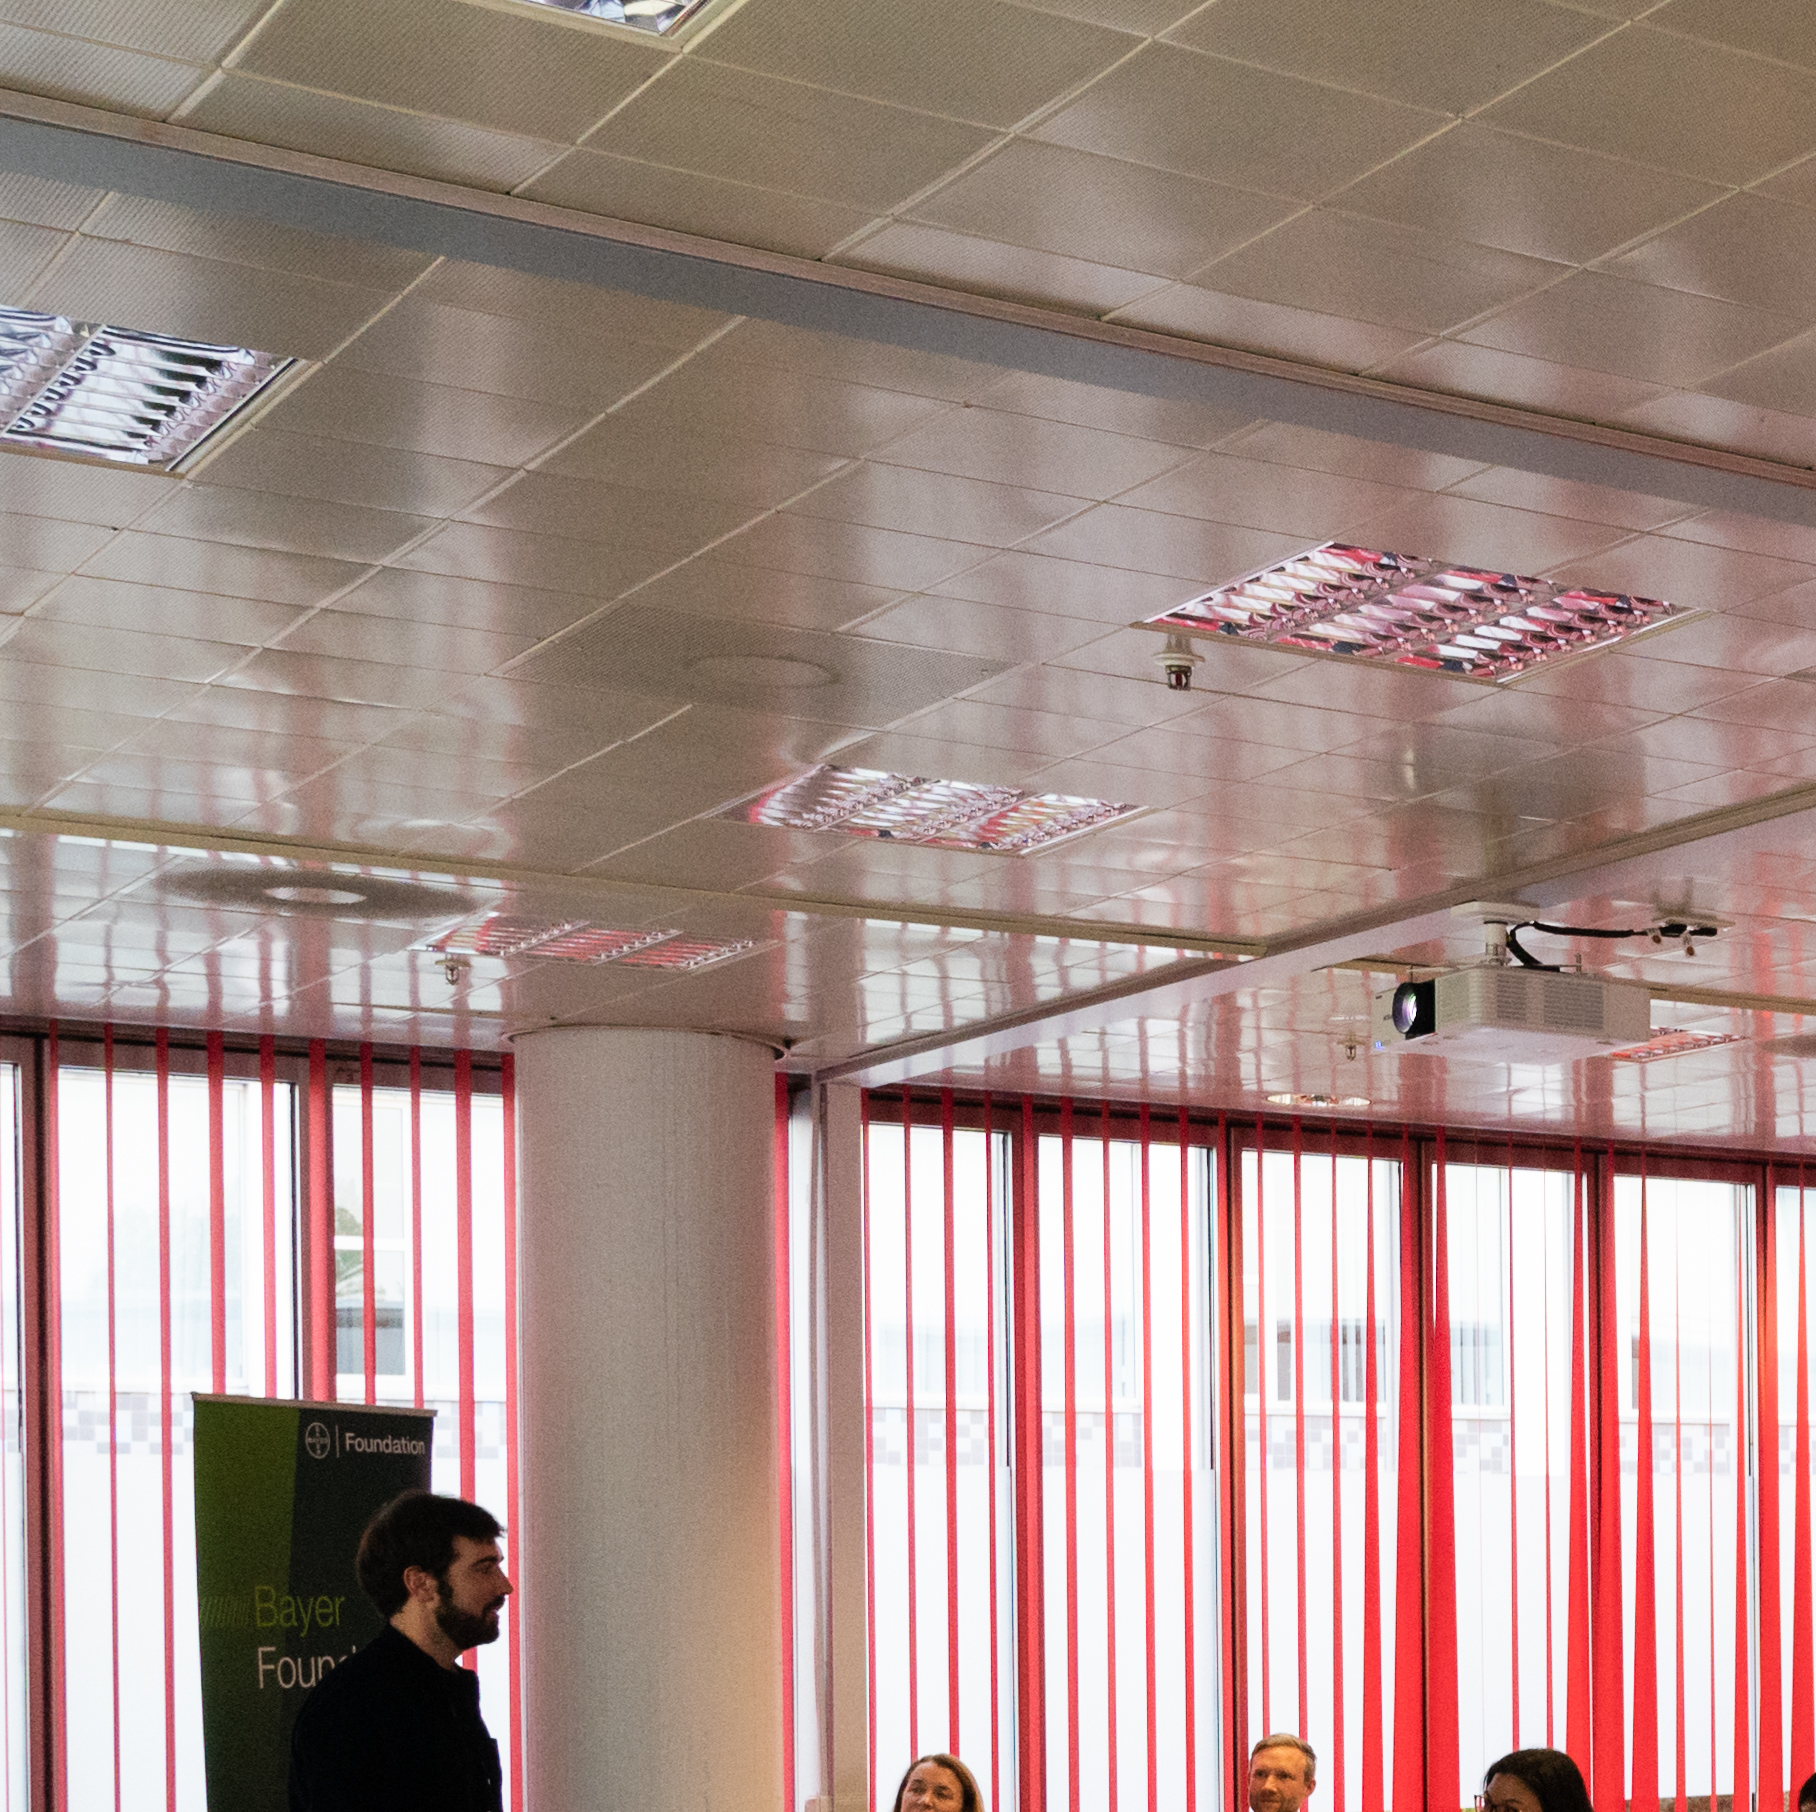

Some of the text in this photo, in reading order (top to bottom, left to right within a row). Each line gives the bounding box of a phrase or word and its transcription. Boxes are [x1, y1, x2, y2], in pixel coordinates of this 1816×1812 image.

[345, 1432, 426, 1455] Foundation
[254, 1585, 346, 1637] Bayer
[256, 1645, 357, 1689] Foun
